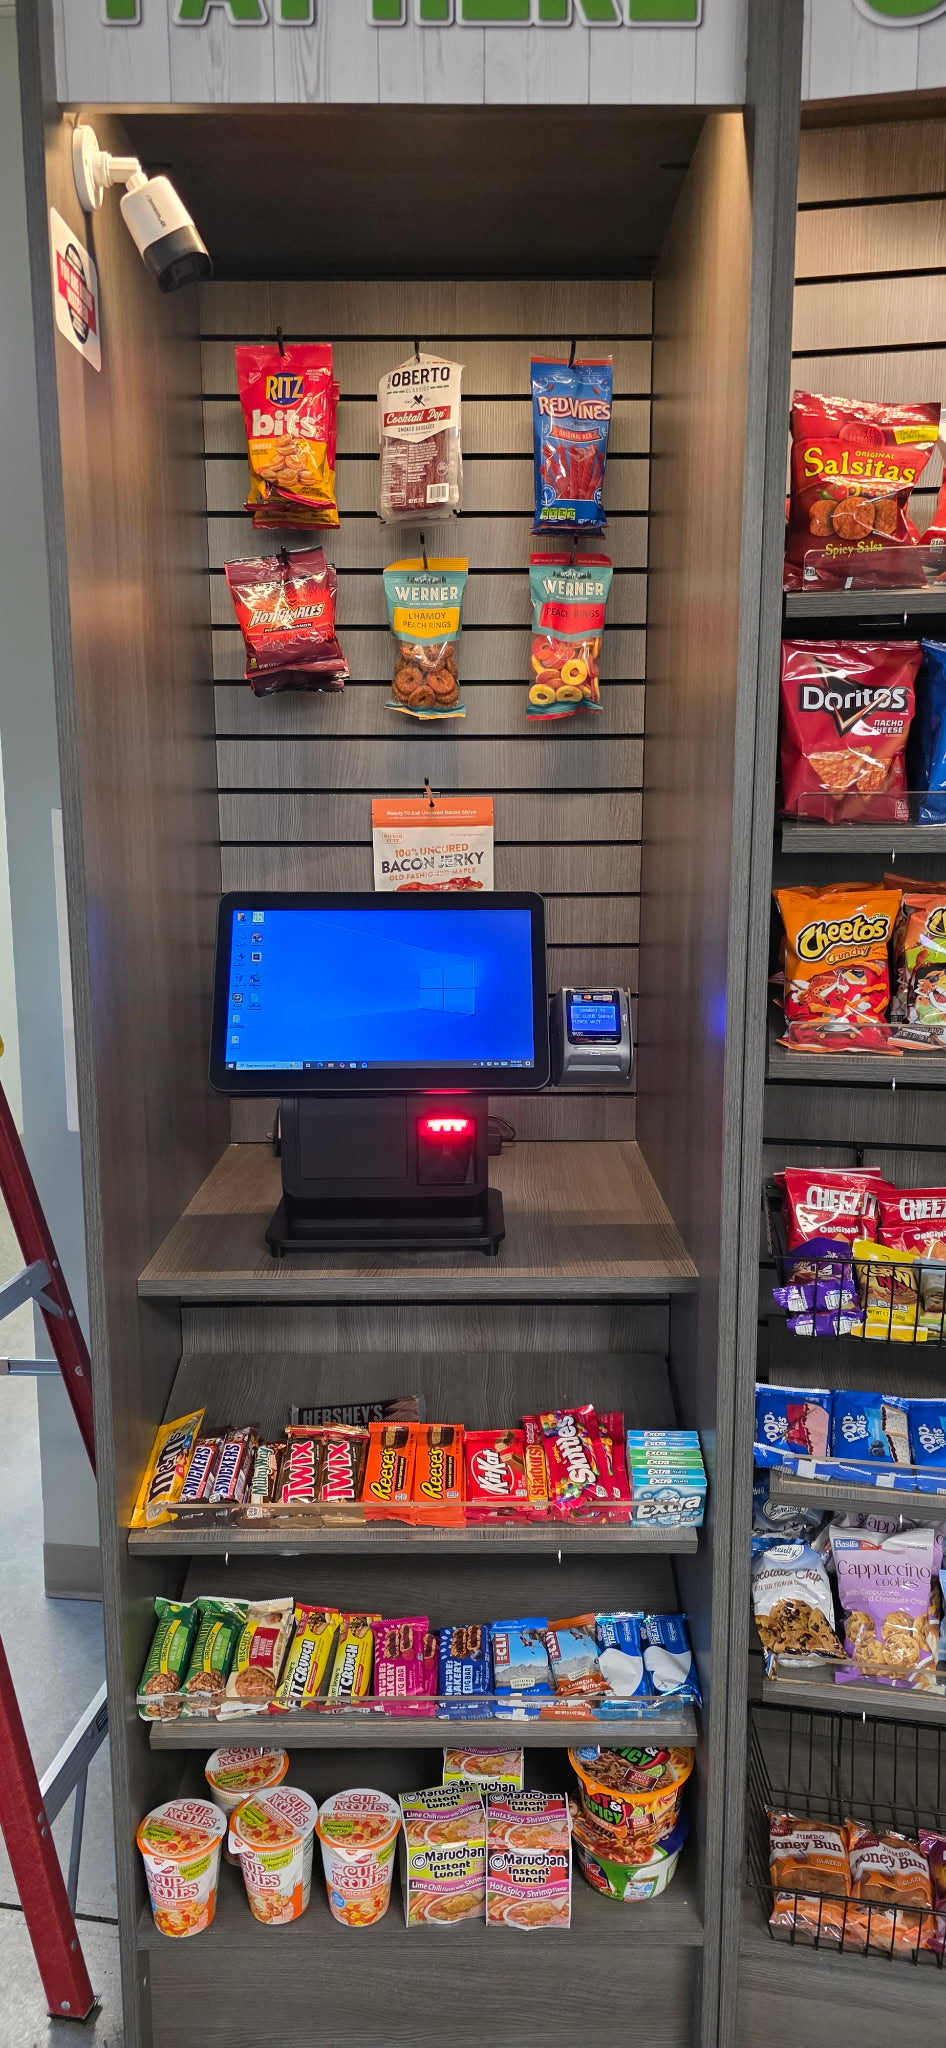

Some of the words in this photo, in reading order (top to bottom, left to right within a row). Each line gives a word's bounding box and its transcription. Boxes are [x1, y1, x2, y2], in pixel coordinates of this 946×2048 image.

[391, 366, 450, 387] OBERTO
[265, 375, 304, 400] RITZ
[252, 409, 317, 438] bits
[386, 409, 424, 426] Cocktail
[558, 430, 581, 440] ORIGINAL
[855, 451, 895, 460] ORIGINAL
[803, 447, 916, 483] Salsitas
[825, 543, 853, 558] Spicy
[856, 541, 883, 553] Salsa
[394, 586, 459, 601] WERNER
[542, 579, 604, 596] WERNER
[249, 609, 275, 627] HOT
[408, 612, 446, 620] CHAMOY
[545, 607, 570, 618] PEACH
[573, 609, 600, 618] RINGS
[402, 620, 427, 629] PEACH
[428, 621, 452, 629] RINGS
[802, 686, 907, 711] Doritos
[872, 726, 904, 734] CHEESE
[874, 719, 904, 727] NACHO
[395, 847, 419, 858] 100%
[420, 843, 469, 856] UNCURED
[381, 856, 435, 874] BACON
[438, 851, 484, 868] JERKY
[406, 869, 451, 880] FASHIONED
[452, 866, 477, 875] MAPLE
[800, 914, 886, 958] Cheetos
[825, 945, 870, 964] Crunchy
[303, 1405, 384, 1425] HERSHEY'S
[555, 1415, 597, 1484] Skittles
[182, 1447, 211, 1497] SNICKERS
[214, 1444, 240, 1495] SNICKERS
[282, 1440, 315, 1503] TWIX
[321, 1441, 355, 1502] TWIX
[370, 1447, 396, 1501] Reese's
[420, 1446, 445, 1500] Reese's
[476, 1448, 511, 1495] KitKat
[530, 1447, 545, 1498] Starburst
[636, 1495, 702, 1519] Extra
[795, 1568, 825, 1584] Chip
[837, 1559, 931, 1585] Cappuccino
[875, 1577, 919, 1589] cookies
[845, 1588, 859, 1596] with
[860, 1588, 899, 1597] Cappuccino
[874, 1595, 909, 1603] Chocolate
[149, 1642, 163, 1673] NATURE
[156, 1620, 172, 1643] VALLEY
[161, 1631, 173, 1662] CRUNCHY
[204, 1631, 216, 1661] CRUNCHY
[238, 1630, 251, 1663] BISCUITS
[265, 1639, 274, 1657] BUTTER
[387, 1662, 395, 1696] AKERY
[398, 1666, 406, 1677] BAR
[464, 1666, 472, 1680] BAR
[349, 1794, 381, 1804] CUP
[415, 1785, 473, 1798] Maruchan
[421, 1794, 462, 1805] Instant
[502, 1791, 564, 1800] Maruchan
[183, 1802, 214, 1816] CUP
[267, 1792, 310, 1828] NOODLES
[285, 1794, 311, 1813] CUP
[333, 1802, 389, 1812] NOODLES
[426, 1800, 459, 1809] Lunch
[584, 1796, 622, 1824] SPICY
[609, 1800, 622, 1813] &
[164, 1807, 217, 1829] NOODLES
[406, 1811, 422, 1819] Lime
[423, 1812, 437, 1820] Chili
[459, 1804, 481, 1815] Shrimp
[526, 1814, 552, 1824] Shrimp
[813, 1839, 842, 1852] Bun
[882, 1846, 910, 1857] JUMBO
[425, 1847, 486, 1862] Maruchan
[504, 1853, 568, 1867] Maruchan
[343, 1862, 381, 1877] CUP
[429, 1861, 471, 1872] Instant
[508, 1866, 550, 1876] Instant
[898, 1856, 927, 1872] Bun
[153, 1874, 186, 1888] CUP
[332, 1867, 389, 1890] NOODLES
[434, 1870, 467, 1879] Lunch
[512, 1875, 546, 1884] Lunch
[411, 1881, 428, 1889] Lime
[428, 1883, 443, 1892] Chili
[526, 1886, 552, 1898] Shrimp
